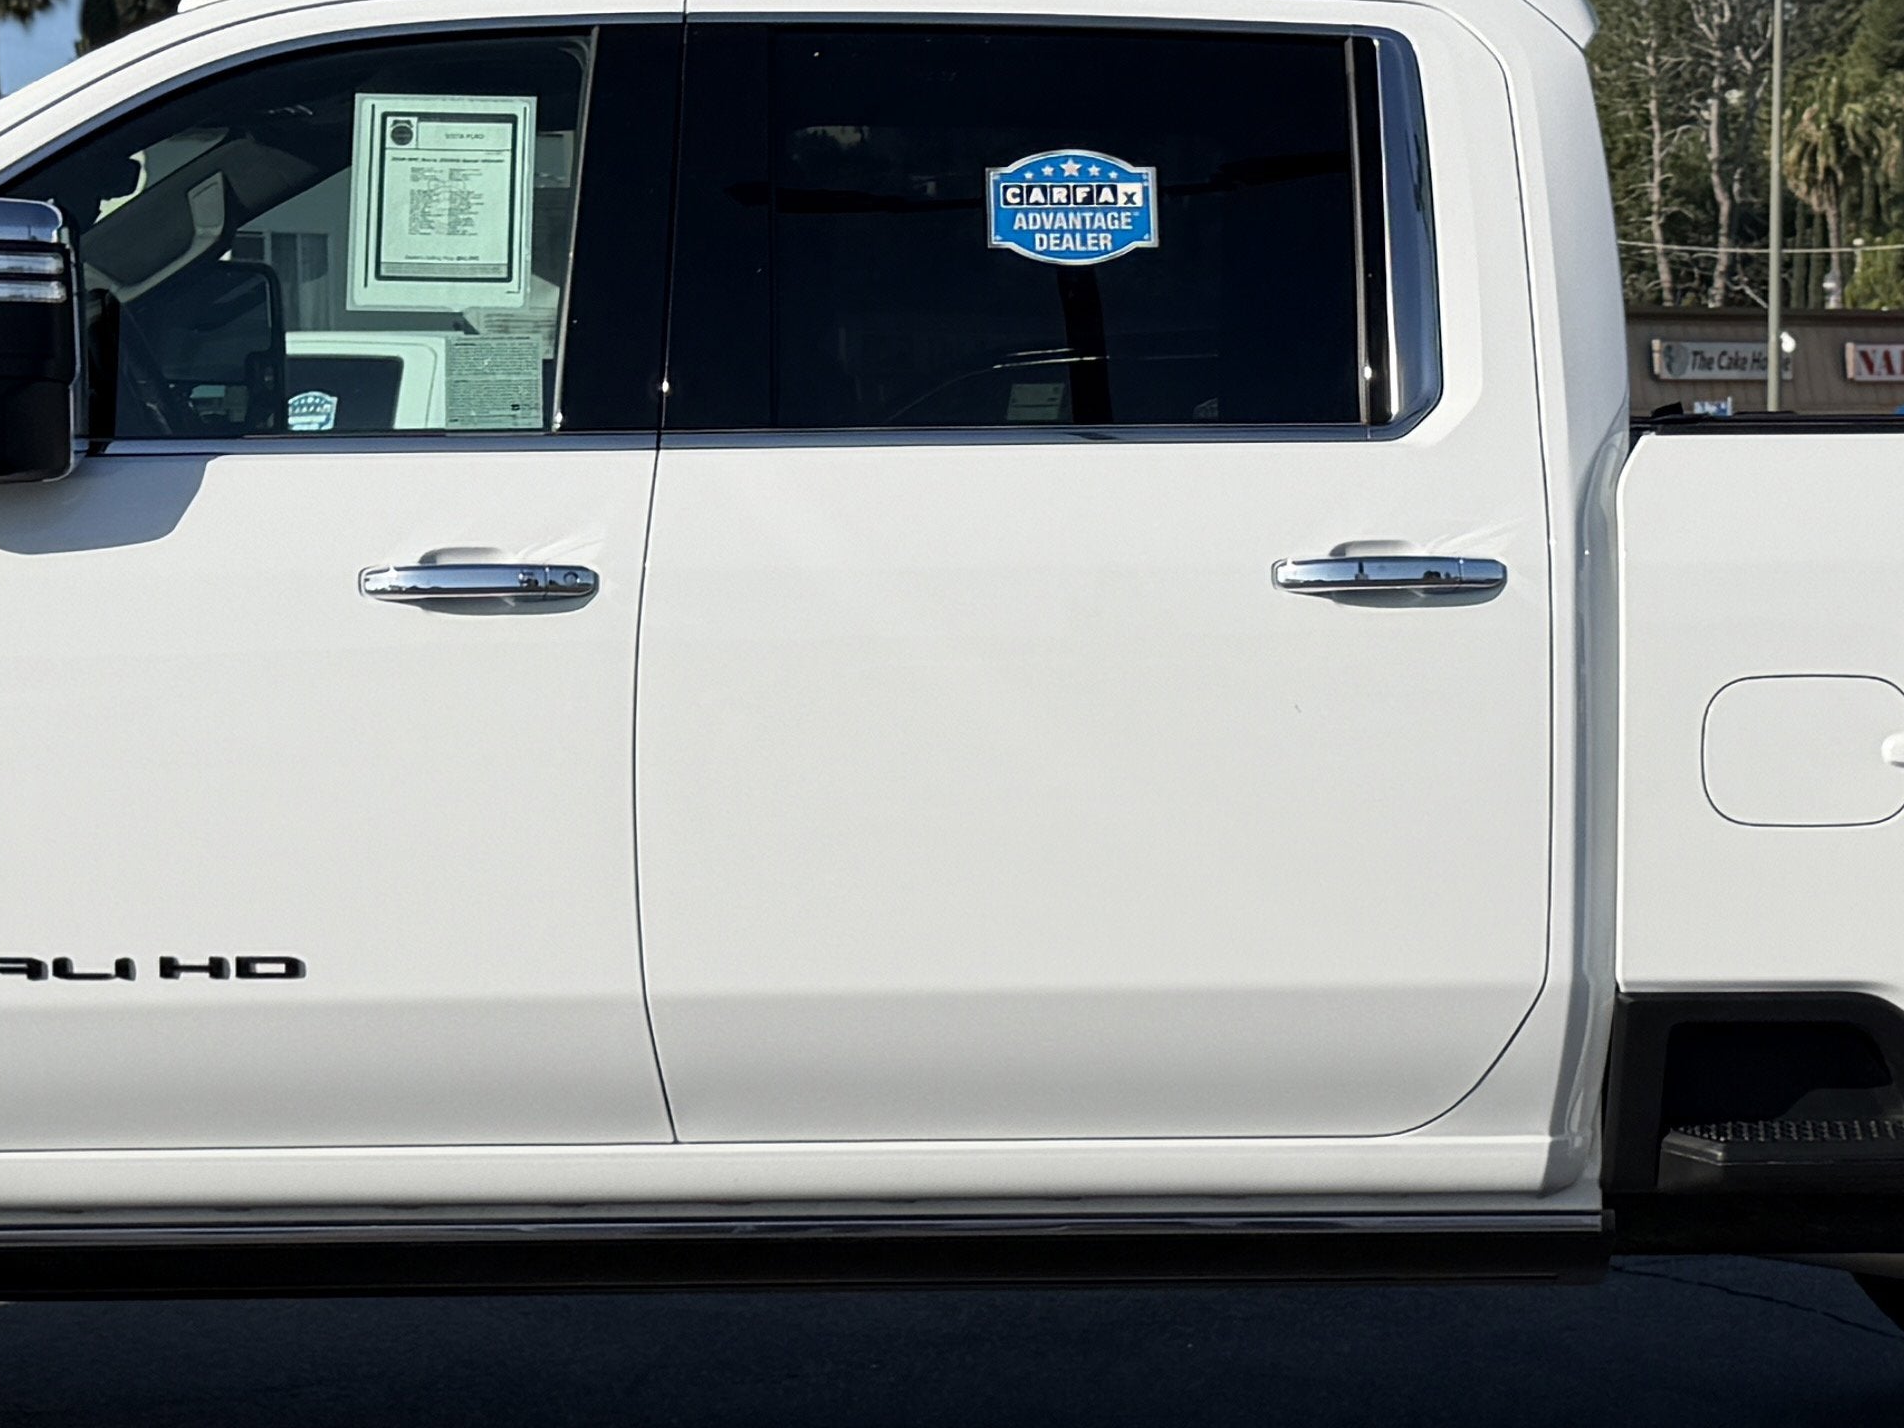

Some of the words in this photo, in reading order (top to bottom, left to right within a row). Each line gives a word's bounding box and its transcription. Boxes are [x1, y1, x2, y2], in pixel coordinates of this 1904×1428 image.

[1003, 184, 1140, 207] CARFAX
[1013, 212, 1133, 230] ADVANTAGE
[1035, 233, 1112, 251] DEALER
[1691, 350, 1714, 370] The
[1717, 350, 1747, 370] Cake
[1750, 351, 1791, 371] Hoe
[159, 956, 306, 980] HD
